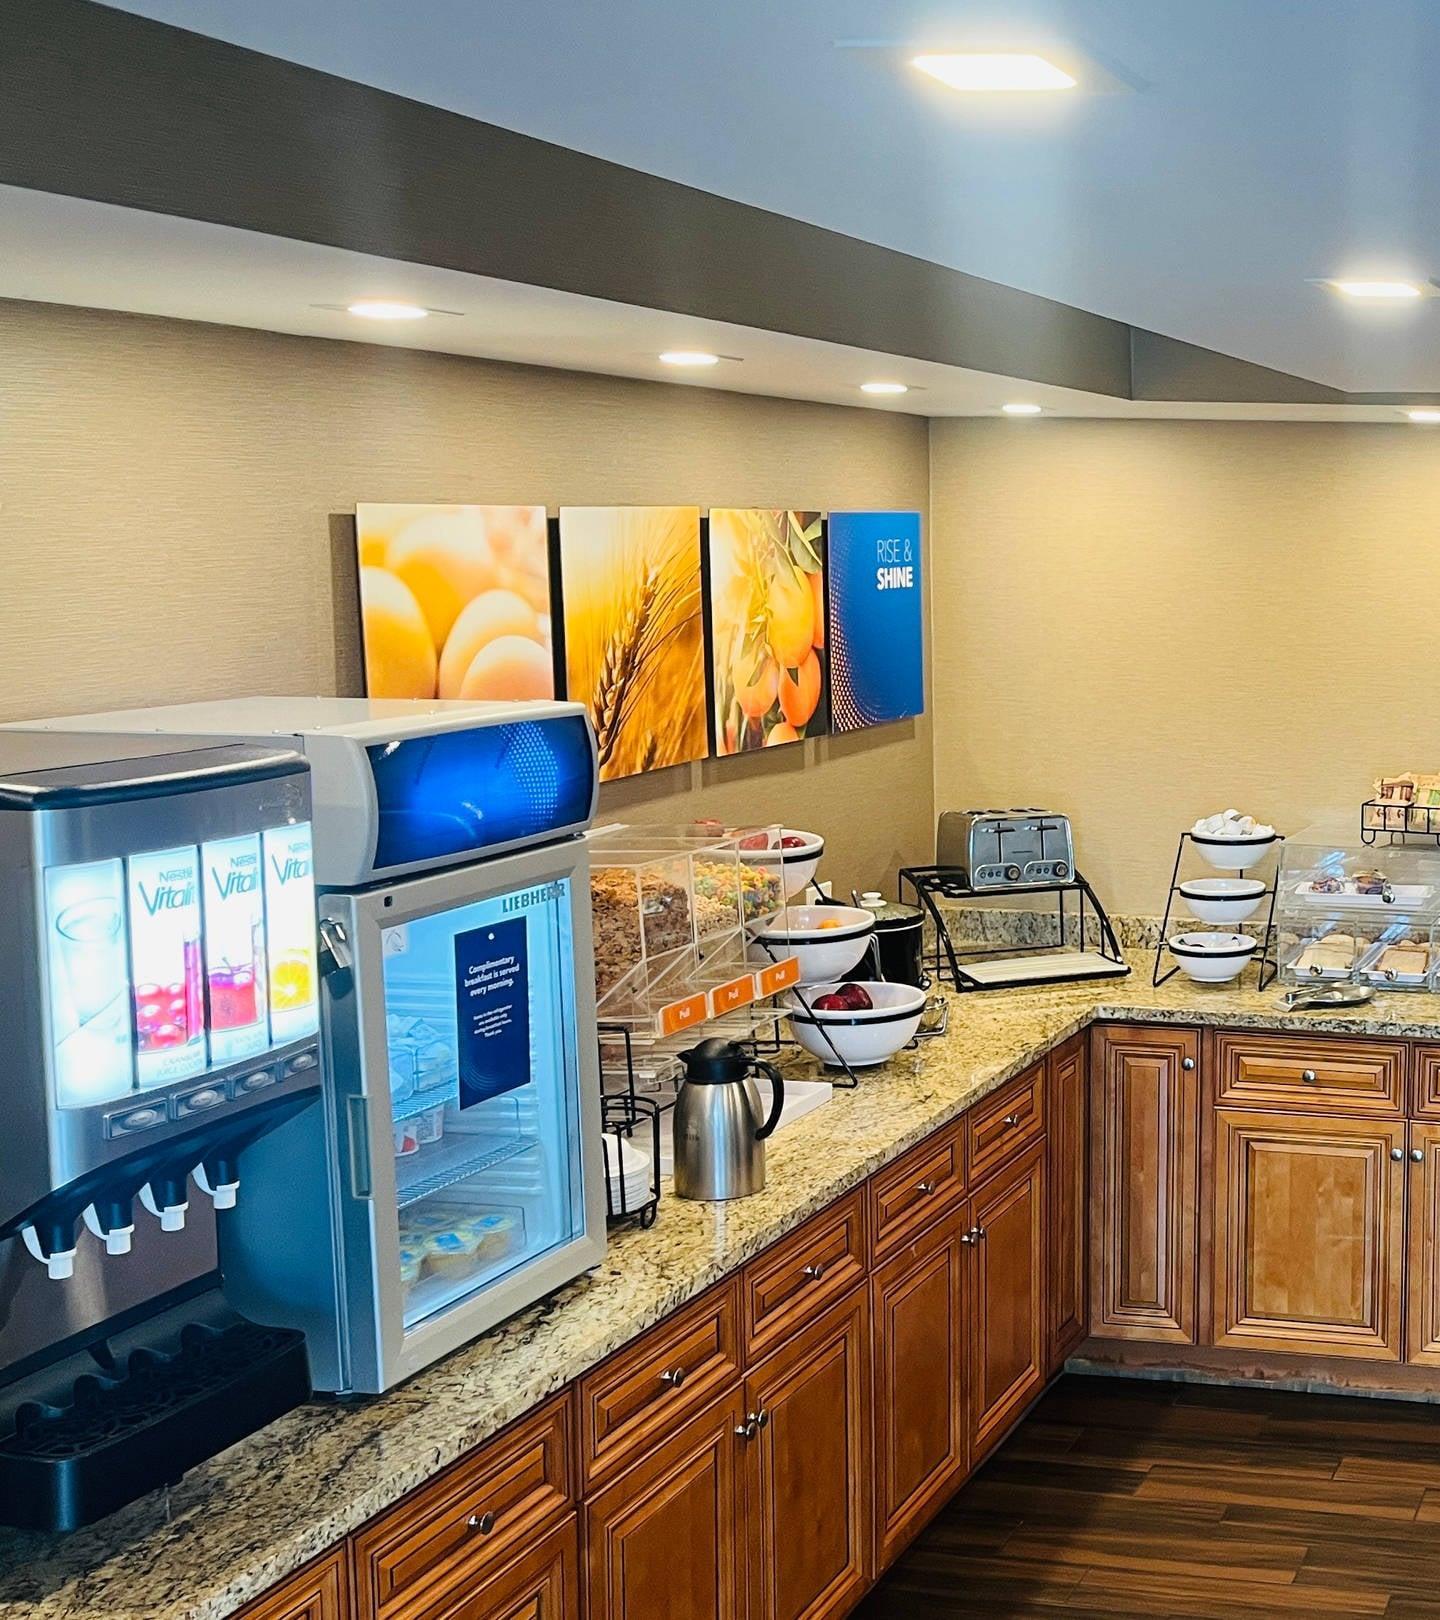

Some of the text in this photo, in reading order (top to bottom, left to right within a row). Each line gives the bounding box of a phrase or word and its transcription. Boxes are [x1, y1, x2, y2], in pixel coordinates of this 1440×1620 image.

[877, 538, 912, 563] RISE &
[876, 566, 914, 591] SHINE
[464, 972, 493, 987] breakfast
[499, 962, 520, 976] served
[468, 956, 515, 974] Complimentary
[470, 986, 487, 997] every
[679, 1006, 691, 1020] Pull
